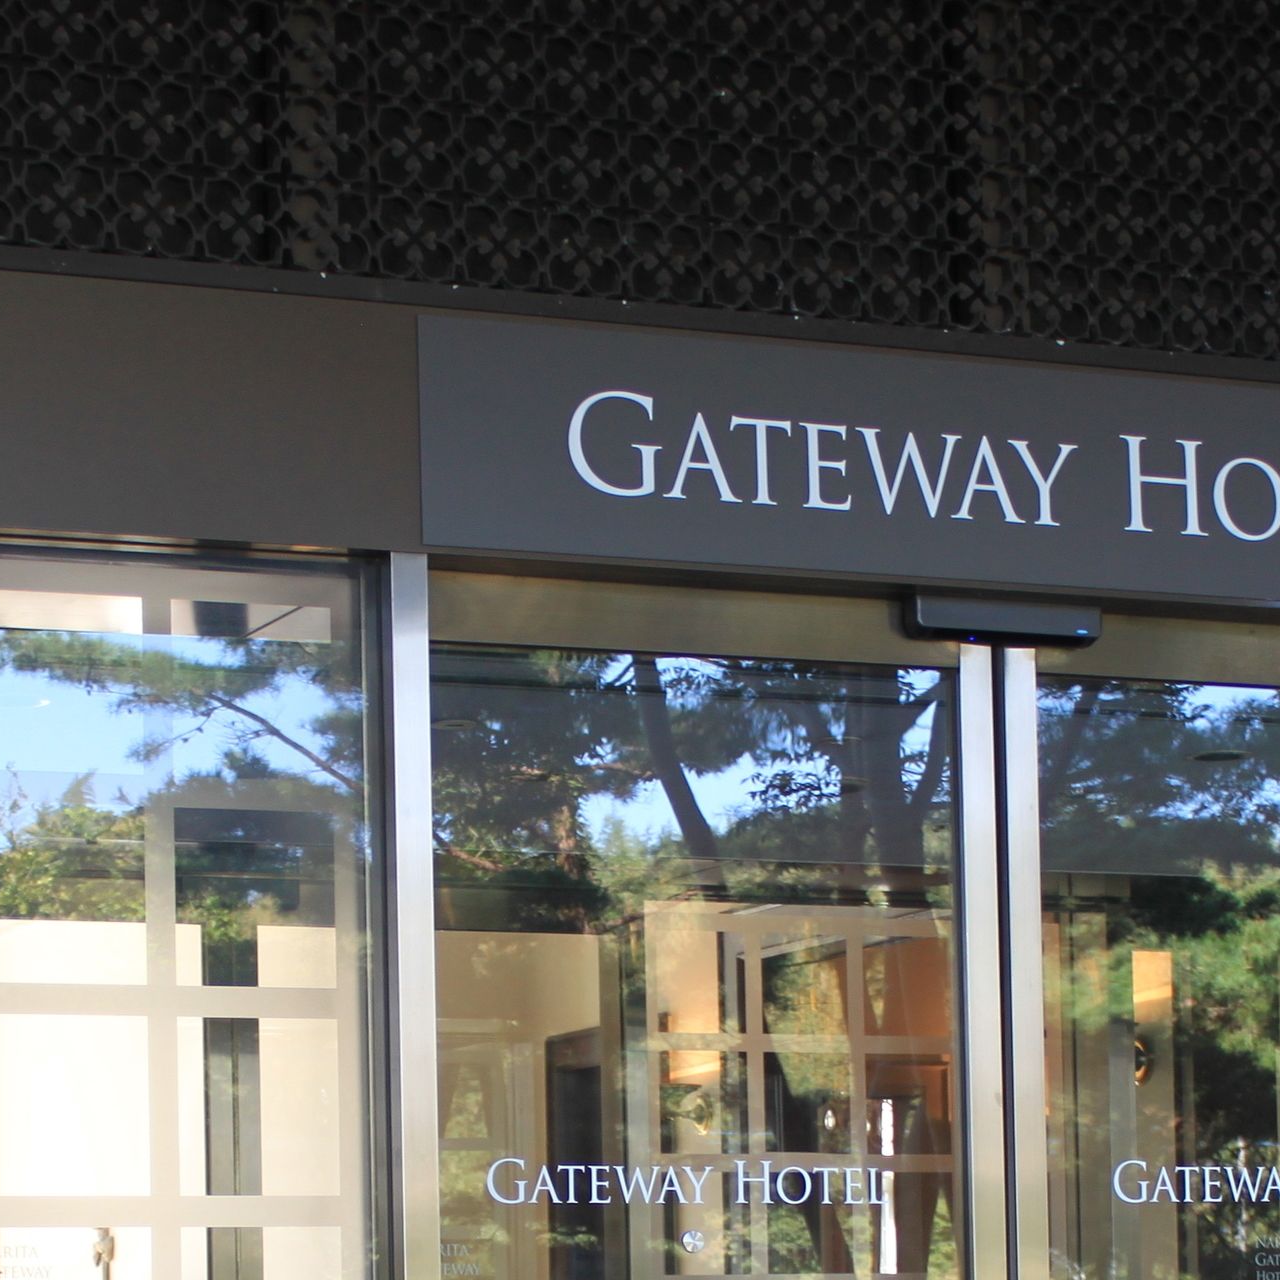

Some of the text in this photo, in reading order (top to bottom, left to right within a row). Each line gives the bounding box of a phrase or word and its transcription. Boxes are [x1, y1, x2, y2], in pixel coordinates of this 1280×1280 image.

[567, 390, 1077, 527] GATEWAY
[486, 1158, 888, 1205] GATEWAY HOTEL
